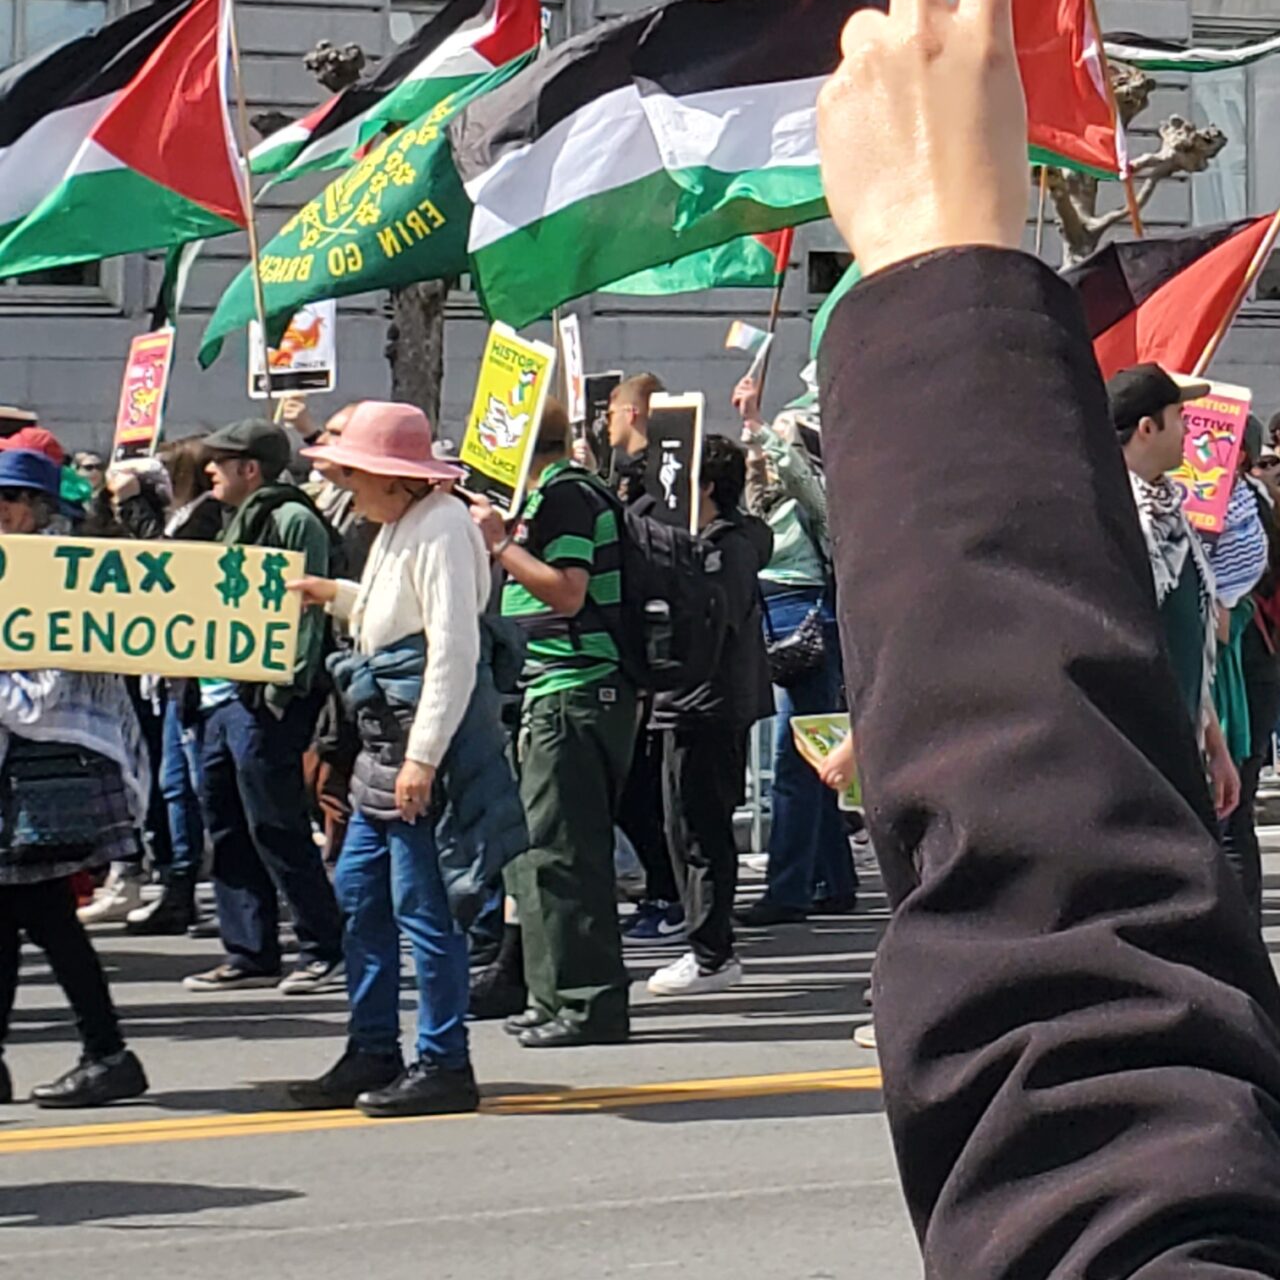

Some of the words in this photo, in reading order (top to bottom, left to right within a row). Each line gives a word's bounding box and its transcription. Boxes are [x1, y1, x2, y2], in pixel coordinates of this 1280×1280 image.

[491, 341, 544, 370] HISTORY
[54, 545, 175, 594] TAX
[2, 607, 291, 671] GENOCIDE
